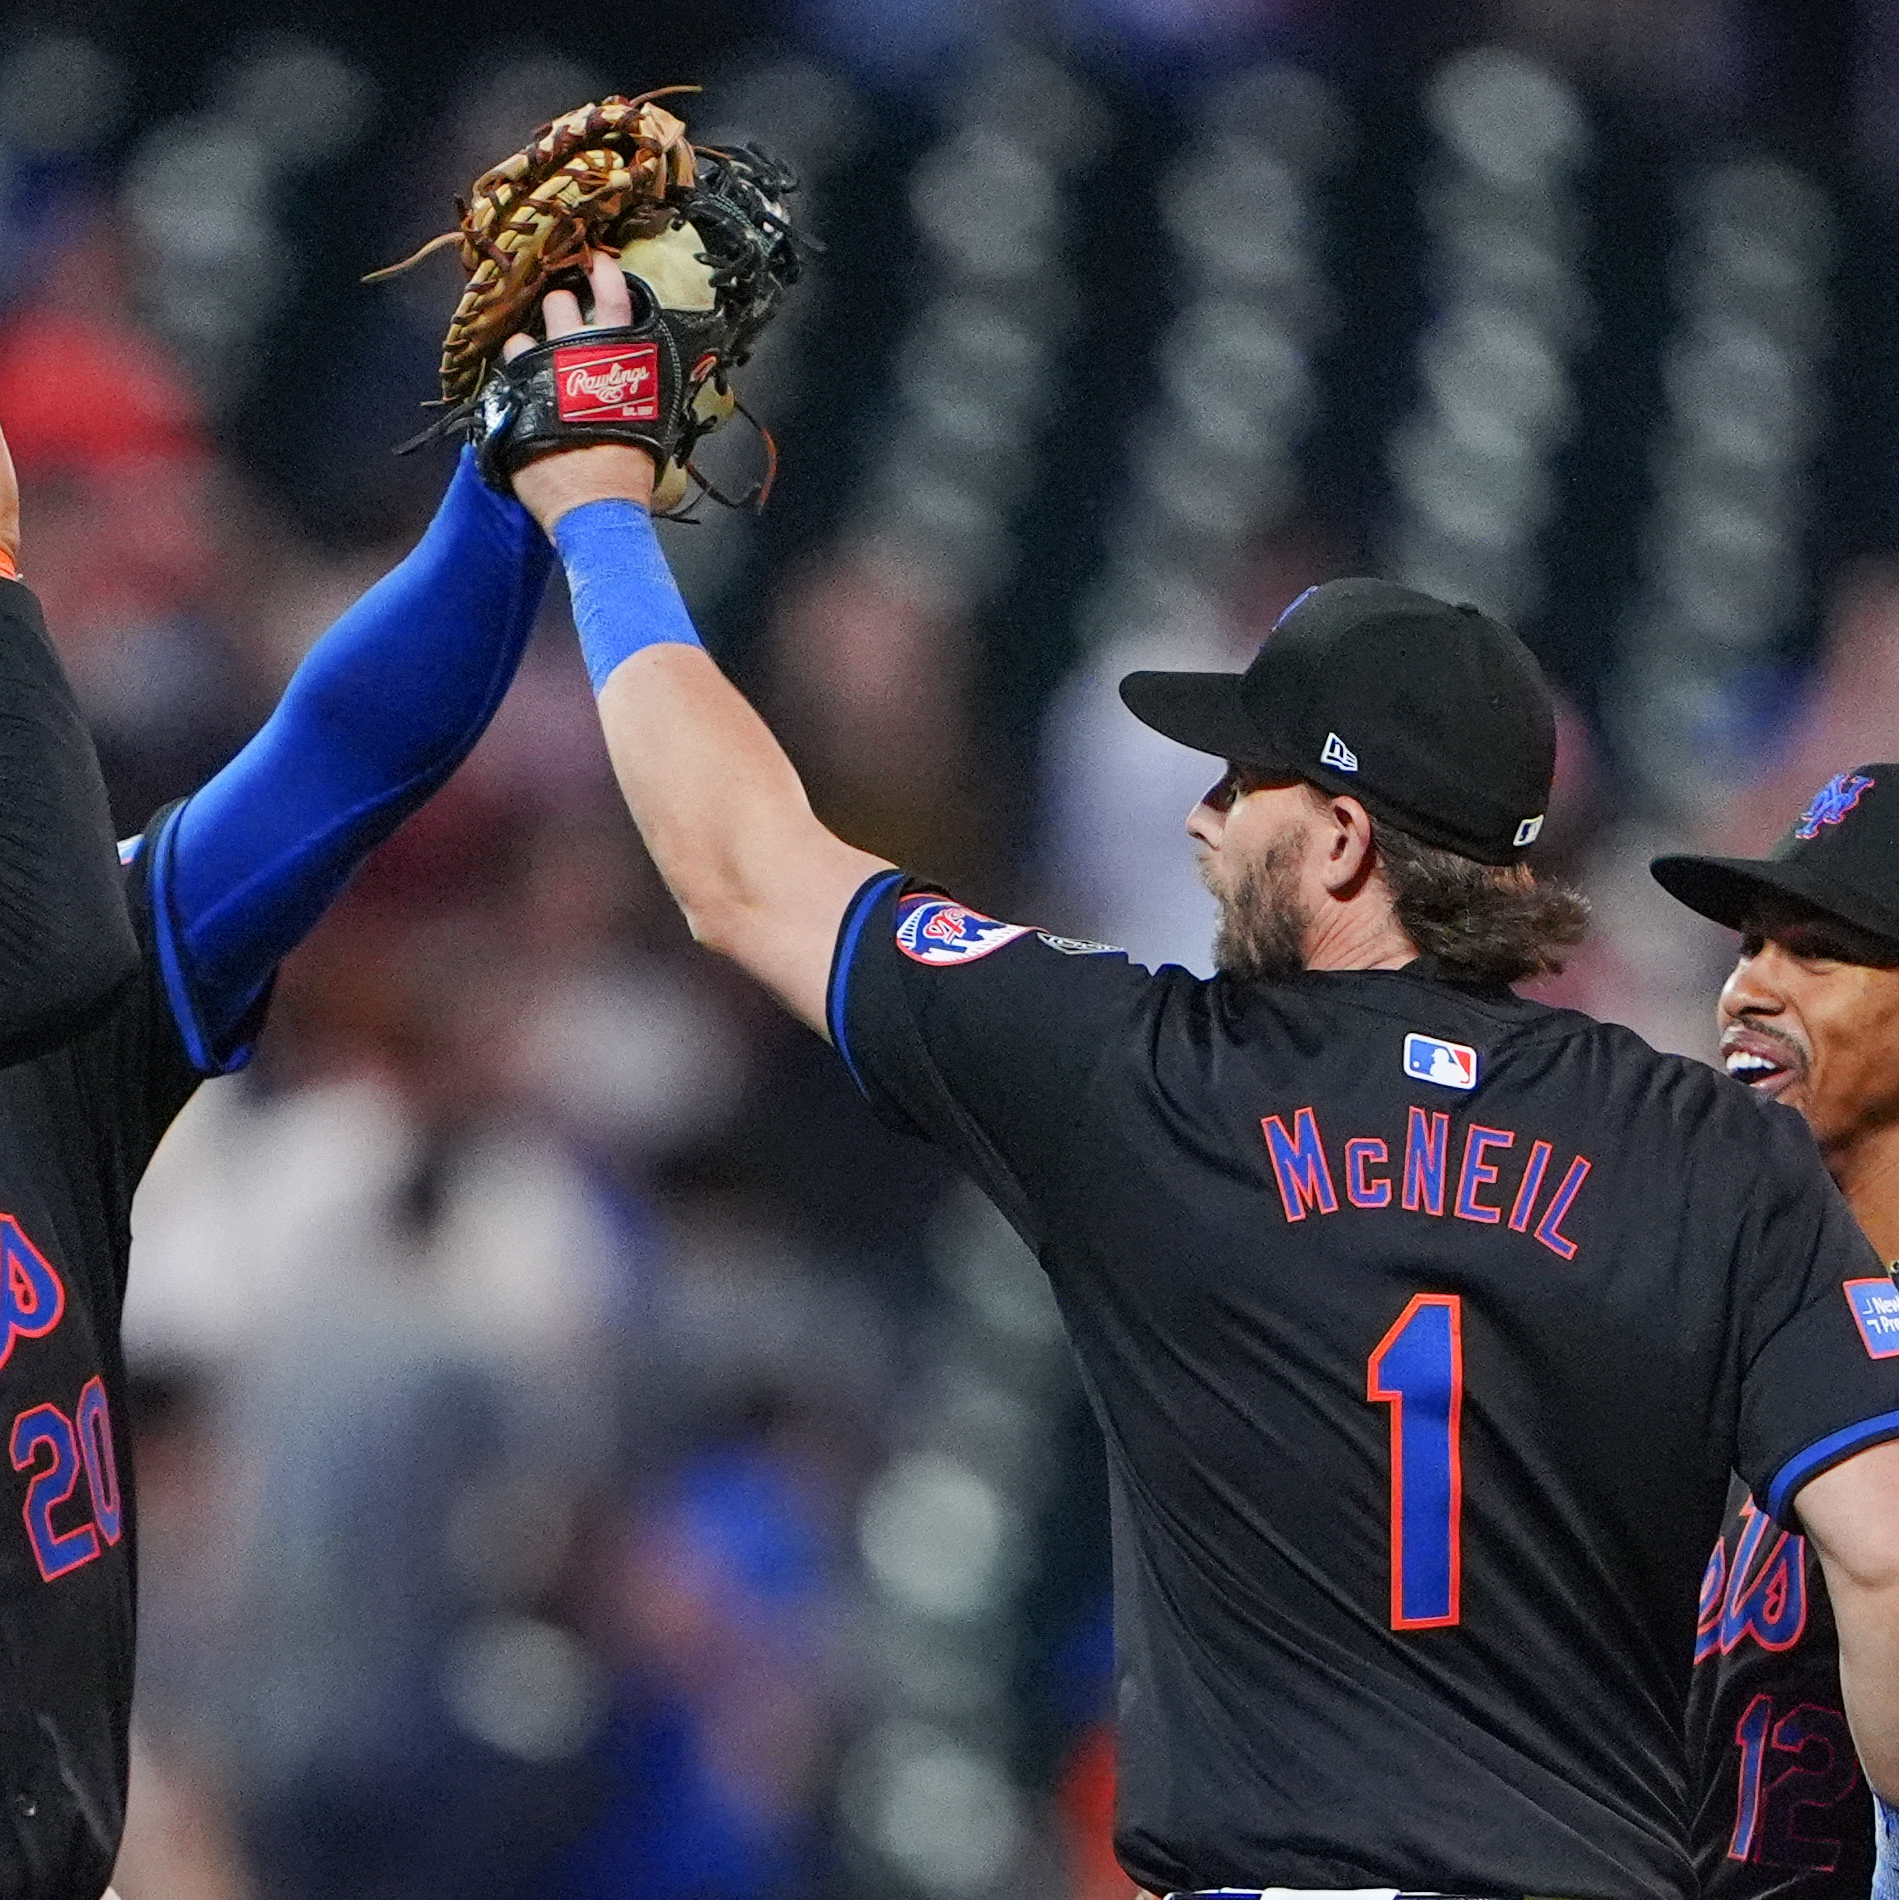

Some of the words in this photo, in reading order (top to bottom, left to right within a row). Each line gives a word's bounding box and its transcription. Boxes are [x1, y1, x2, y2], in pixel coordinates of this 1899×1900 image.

[567, 363, 650, 396] Rawlings
[10, 1375, 122, 1583] 20
[1366, 1293, 1464, 1632] 1
[1693, 1492, 1807, 1666] ets
[1727, 1693, 1859, 1873] 12
